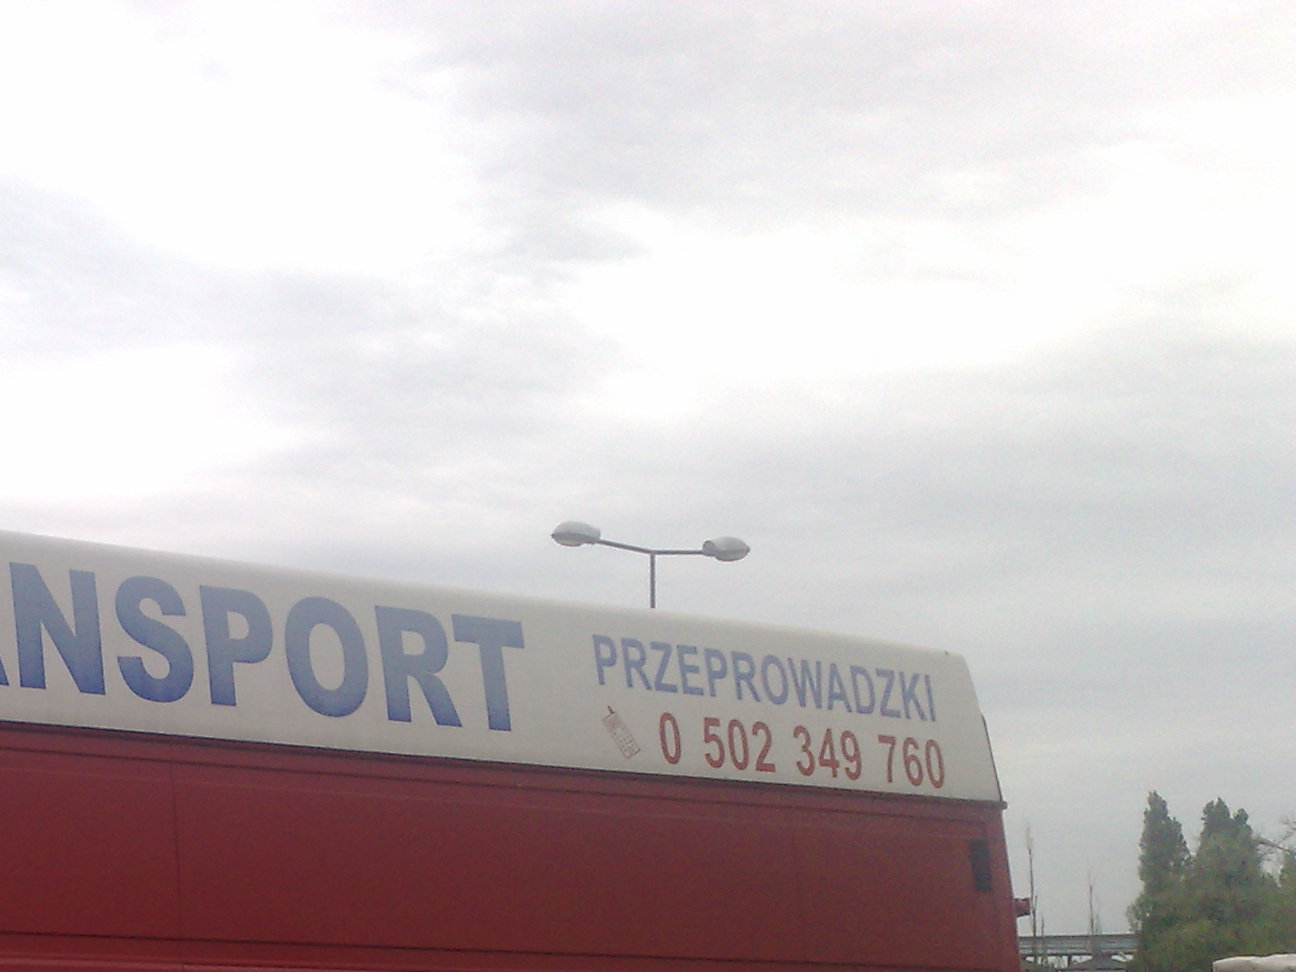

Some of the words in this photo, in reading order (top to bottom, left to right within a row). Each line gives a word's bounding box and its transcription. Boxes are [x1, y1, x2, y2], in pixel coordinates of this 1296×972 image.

[593, 634, 937, 723] PRZEPROWADZKI
[659, 712, 682, 765] 0
[704, 717, 776, 773] 502
[793, 725, 862, 781] 349
[878, 734, 946, 789] 760
